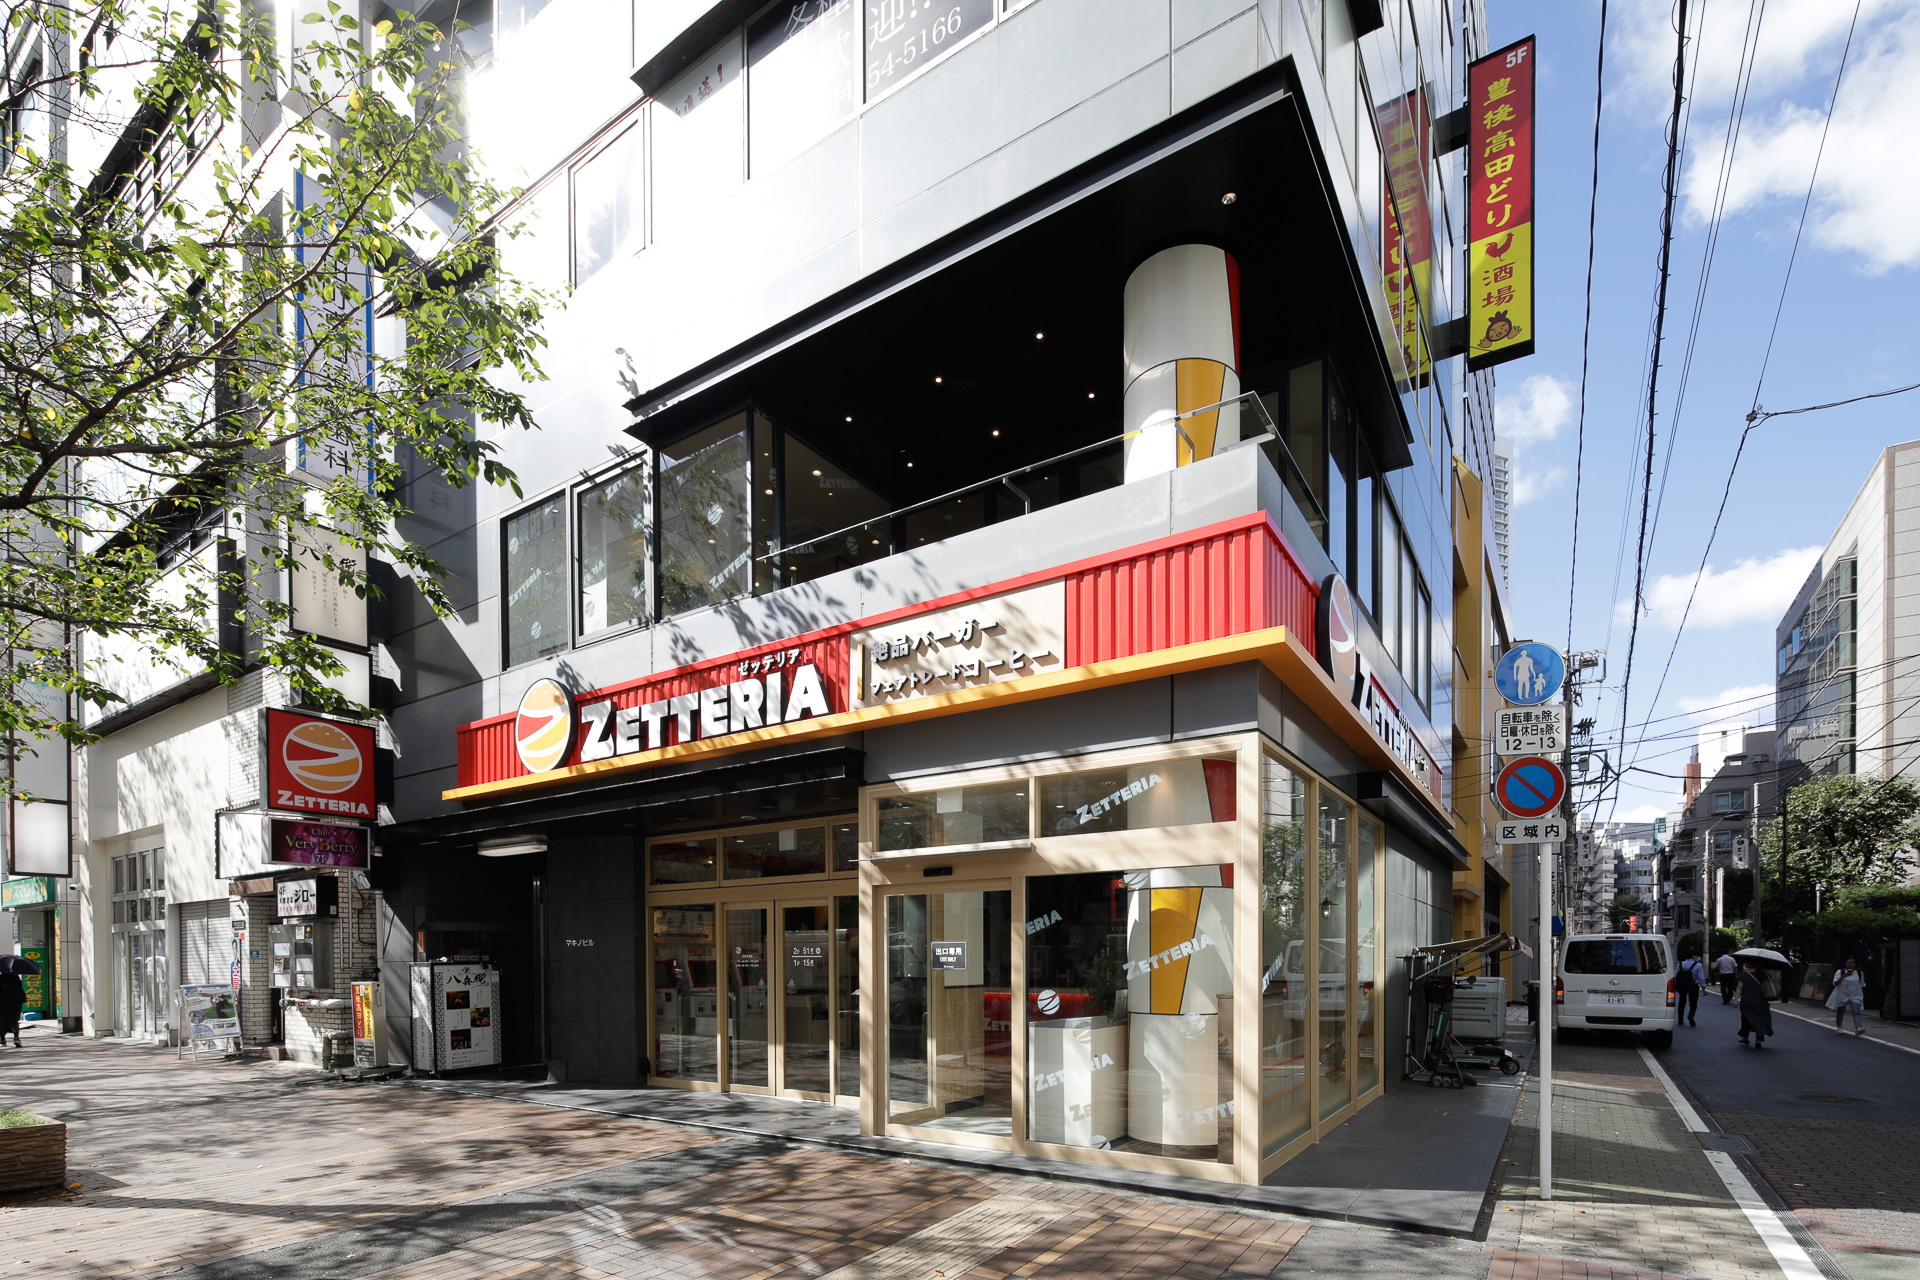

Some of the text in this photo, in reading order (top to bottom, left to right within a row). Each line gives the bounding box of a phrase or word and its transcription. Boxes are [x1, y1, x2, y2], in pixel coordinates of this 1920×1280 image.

[1506, 46, 1527, 68] 5F
[1483, 77, 1515, 228] 豊後高田どり
[1482, 261, 1516, 308] 酒場
[508, 567, 542, 607] ZETTERIA
[870, 620, 998, 663] 絶品バーガー
[737, 647, 801, 676] ゼッテリア
[869, 649, 1051, 697] フェアトレードコーヒー
[579, 663, 830, 762] ZETTERIA
[1501, 709, 1561, 725] 自転車を除く
[1500, 723, 1561, 738] 日曜・休日を除く
[277, 789, 370, 815] ZETTERIA
[1076, 772, 1162, 825] ZETTERIA
[311, 828, 331, 836] Club
[1502, 824, 1559, 839] 区域内
[285, 835, 358, 856] Very Berry
[315, 855, 328, 863] 7F
[294, 888, 316, 904] ジロー
[565, 939, 595, 947] マキノビル
[935, 946, 962, 956] 出口専用
[1122, 932, 1215, 981] ZETTERIA
